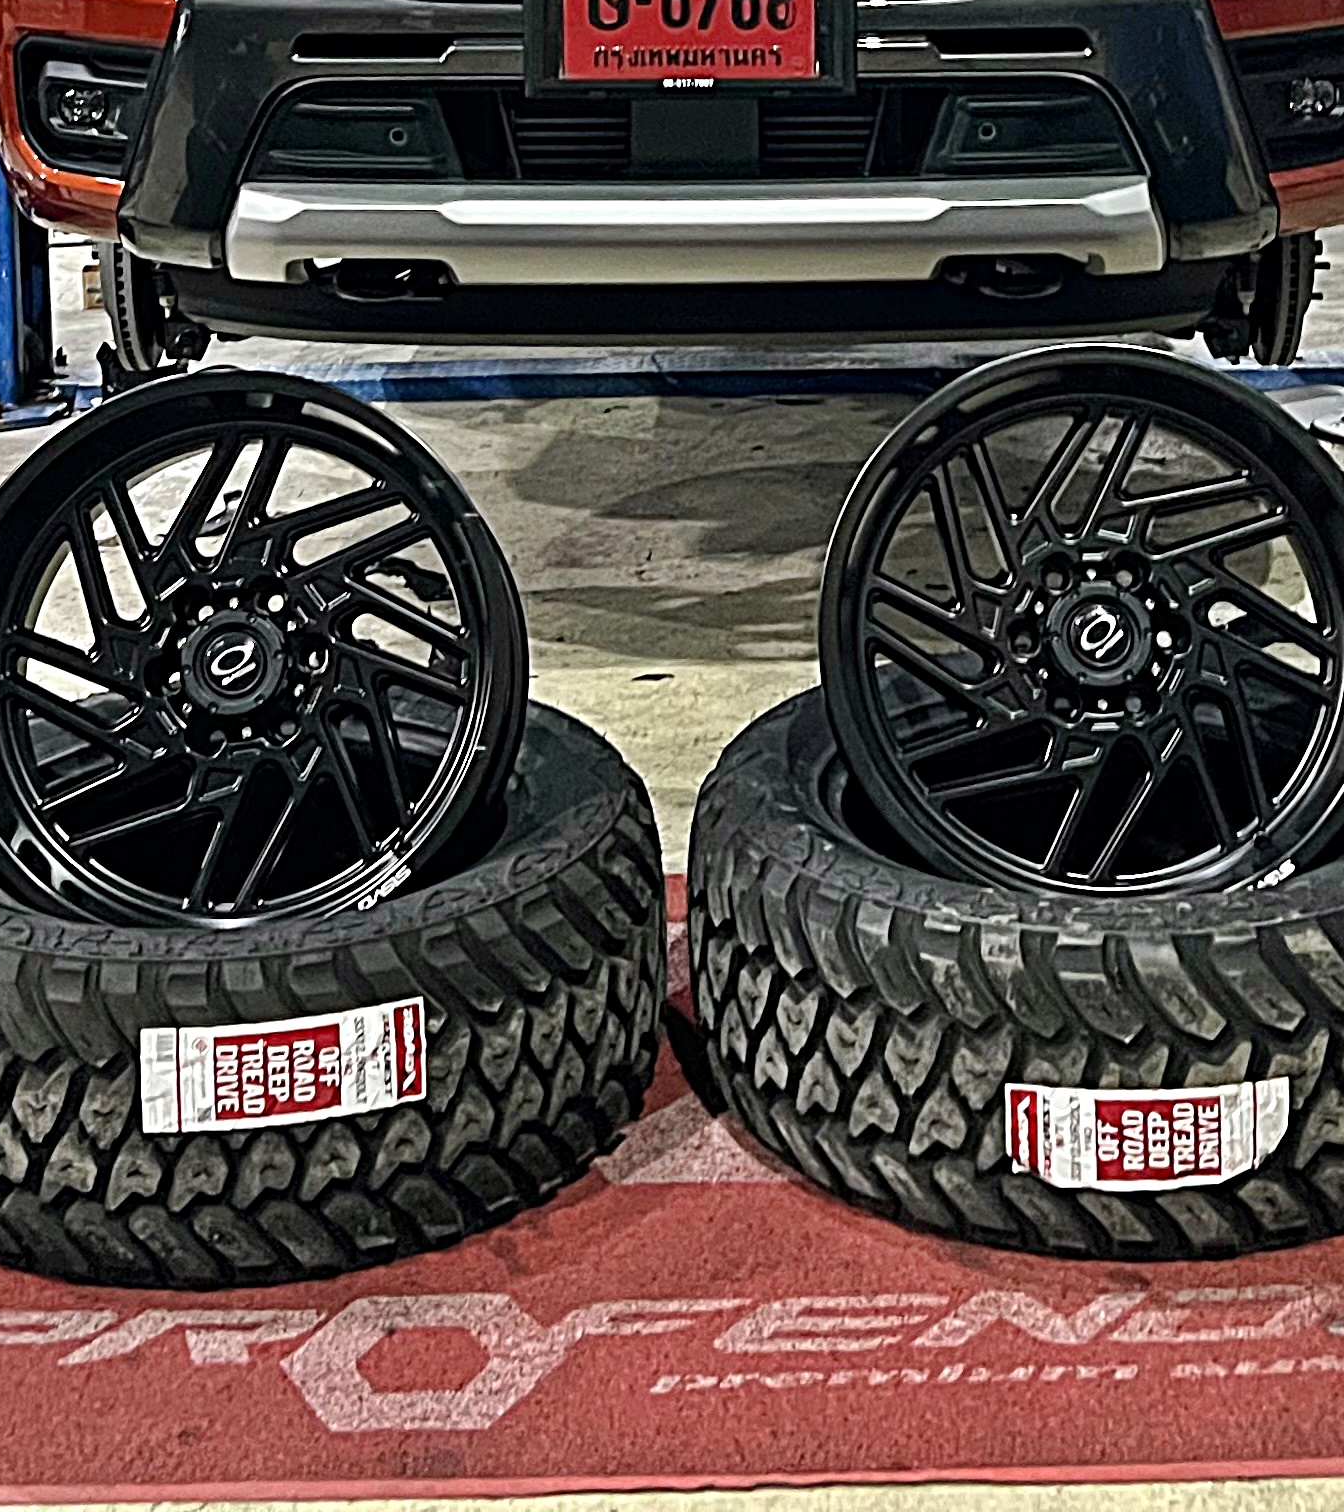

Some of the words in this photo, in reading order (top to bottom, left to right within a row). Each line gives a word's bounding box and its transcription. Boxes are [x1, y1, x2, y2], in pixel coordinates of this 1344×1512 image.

[593, 44, 783, 72] กรุงเทพมหานคร
[358, 864, 412, 912] OASIS
[215, 1045, 239, 1114] DRIVE
[241, 1038, 266, 1115] TREAD
[267, 1044, 290, 1103] DEEP
[292, 1039, 316, 1103] ROAD
[317, 1045, 341, 1088] OFF
[1097, 1119, 1120, 1162] OFF
[1121, 1108, 1145, 1172] ROAD
[1147, 1110, 1171, 1169] DEEP
[1172, 1102, 1196, 1175] TREAD
[1197, 1102, 1220, 1170] DRIVE
